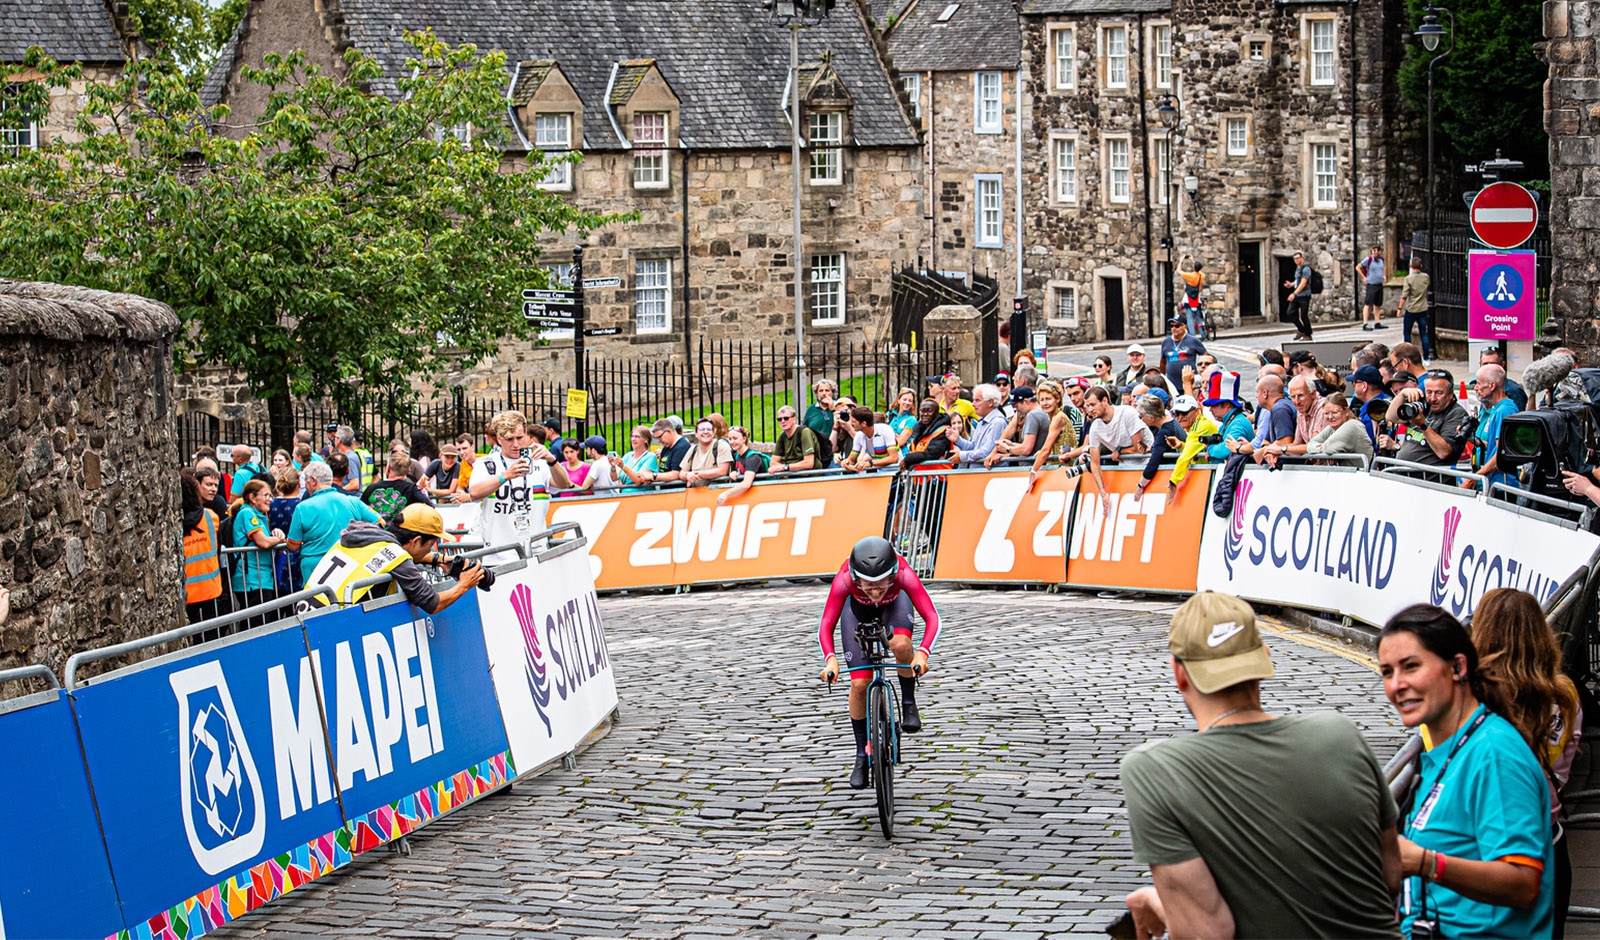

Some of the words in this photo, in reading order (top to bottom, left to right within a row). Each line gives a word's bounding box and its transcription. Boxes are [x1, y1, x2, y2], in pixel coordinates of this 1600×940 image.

[1484, 314, 1518, 324] Crossing
[1491, 323, 1511, 331] Point
[629, 498, 826, 567] ZWIFT
[1032, 490, 1167, 563] ZWIFT
[1249, 505, 1397, 590] SCOTLAND
[318, 555, 347, 585] T
[267, 618, 445, 821] MAPEI
